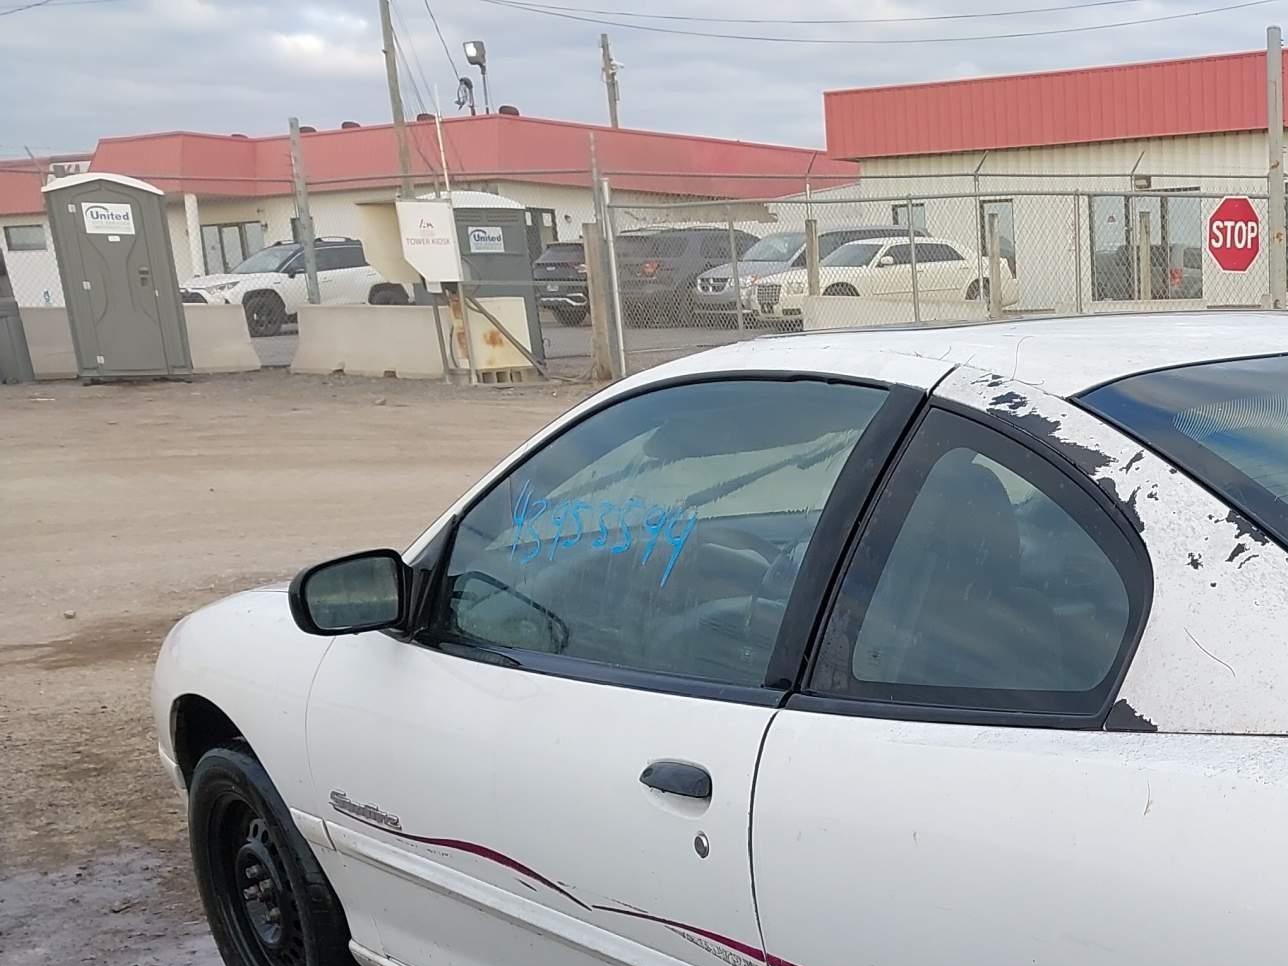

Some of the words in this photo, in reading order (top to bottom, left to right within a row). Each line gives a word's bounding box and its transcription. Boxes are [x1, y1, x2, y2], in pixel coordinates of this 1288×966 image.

[90, 210, 129, 221] United
[473, 233, 502, 242] United
[1211, 220, 1258, 249] STOP
[406, 238, 431, 246] TOWER
